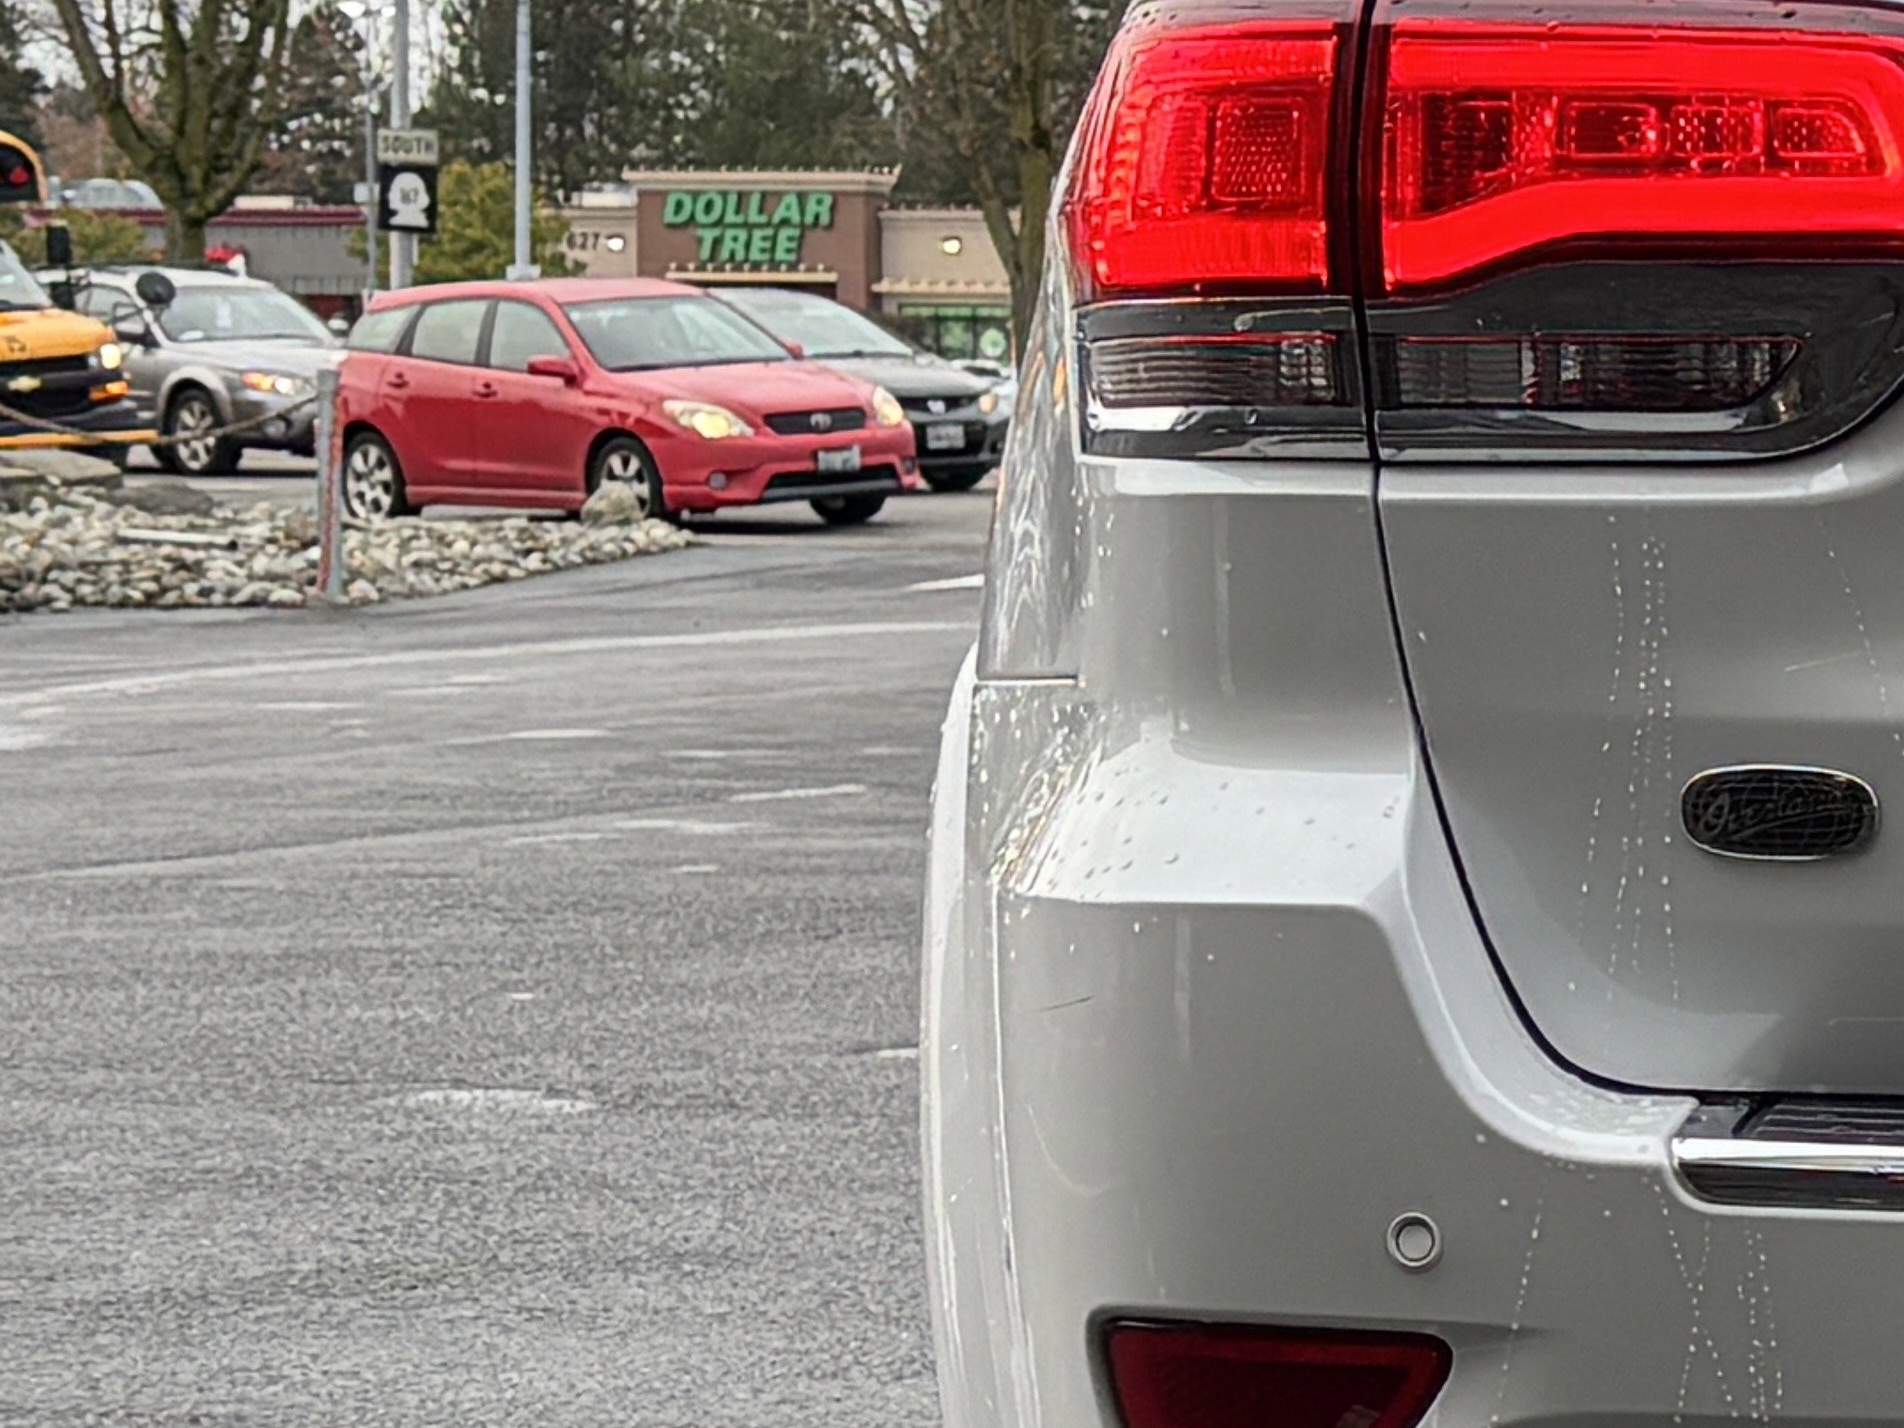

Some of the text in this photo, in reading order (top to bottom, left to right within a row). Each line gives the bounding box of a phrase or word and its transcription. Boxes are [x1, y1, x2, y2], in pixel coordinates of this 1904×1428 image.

[382, 134, 435, 155] SOUTH
[663, 191, 835, 226] DOLLAR
[695, 227, 802, 262] TREE
